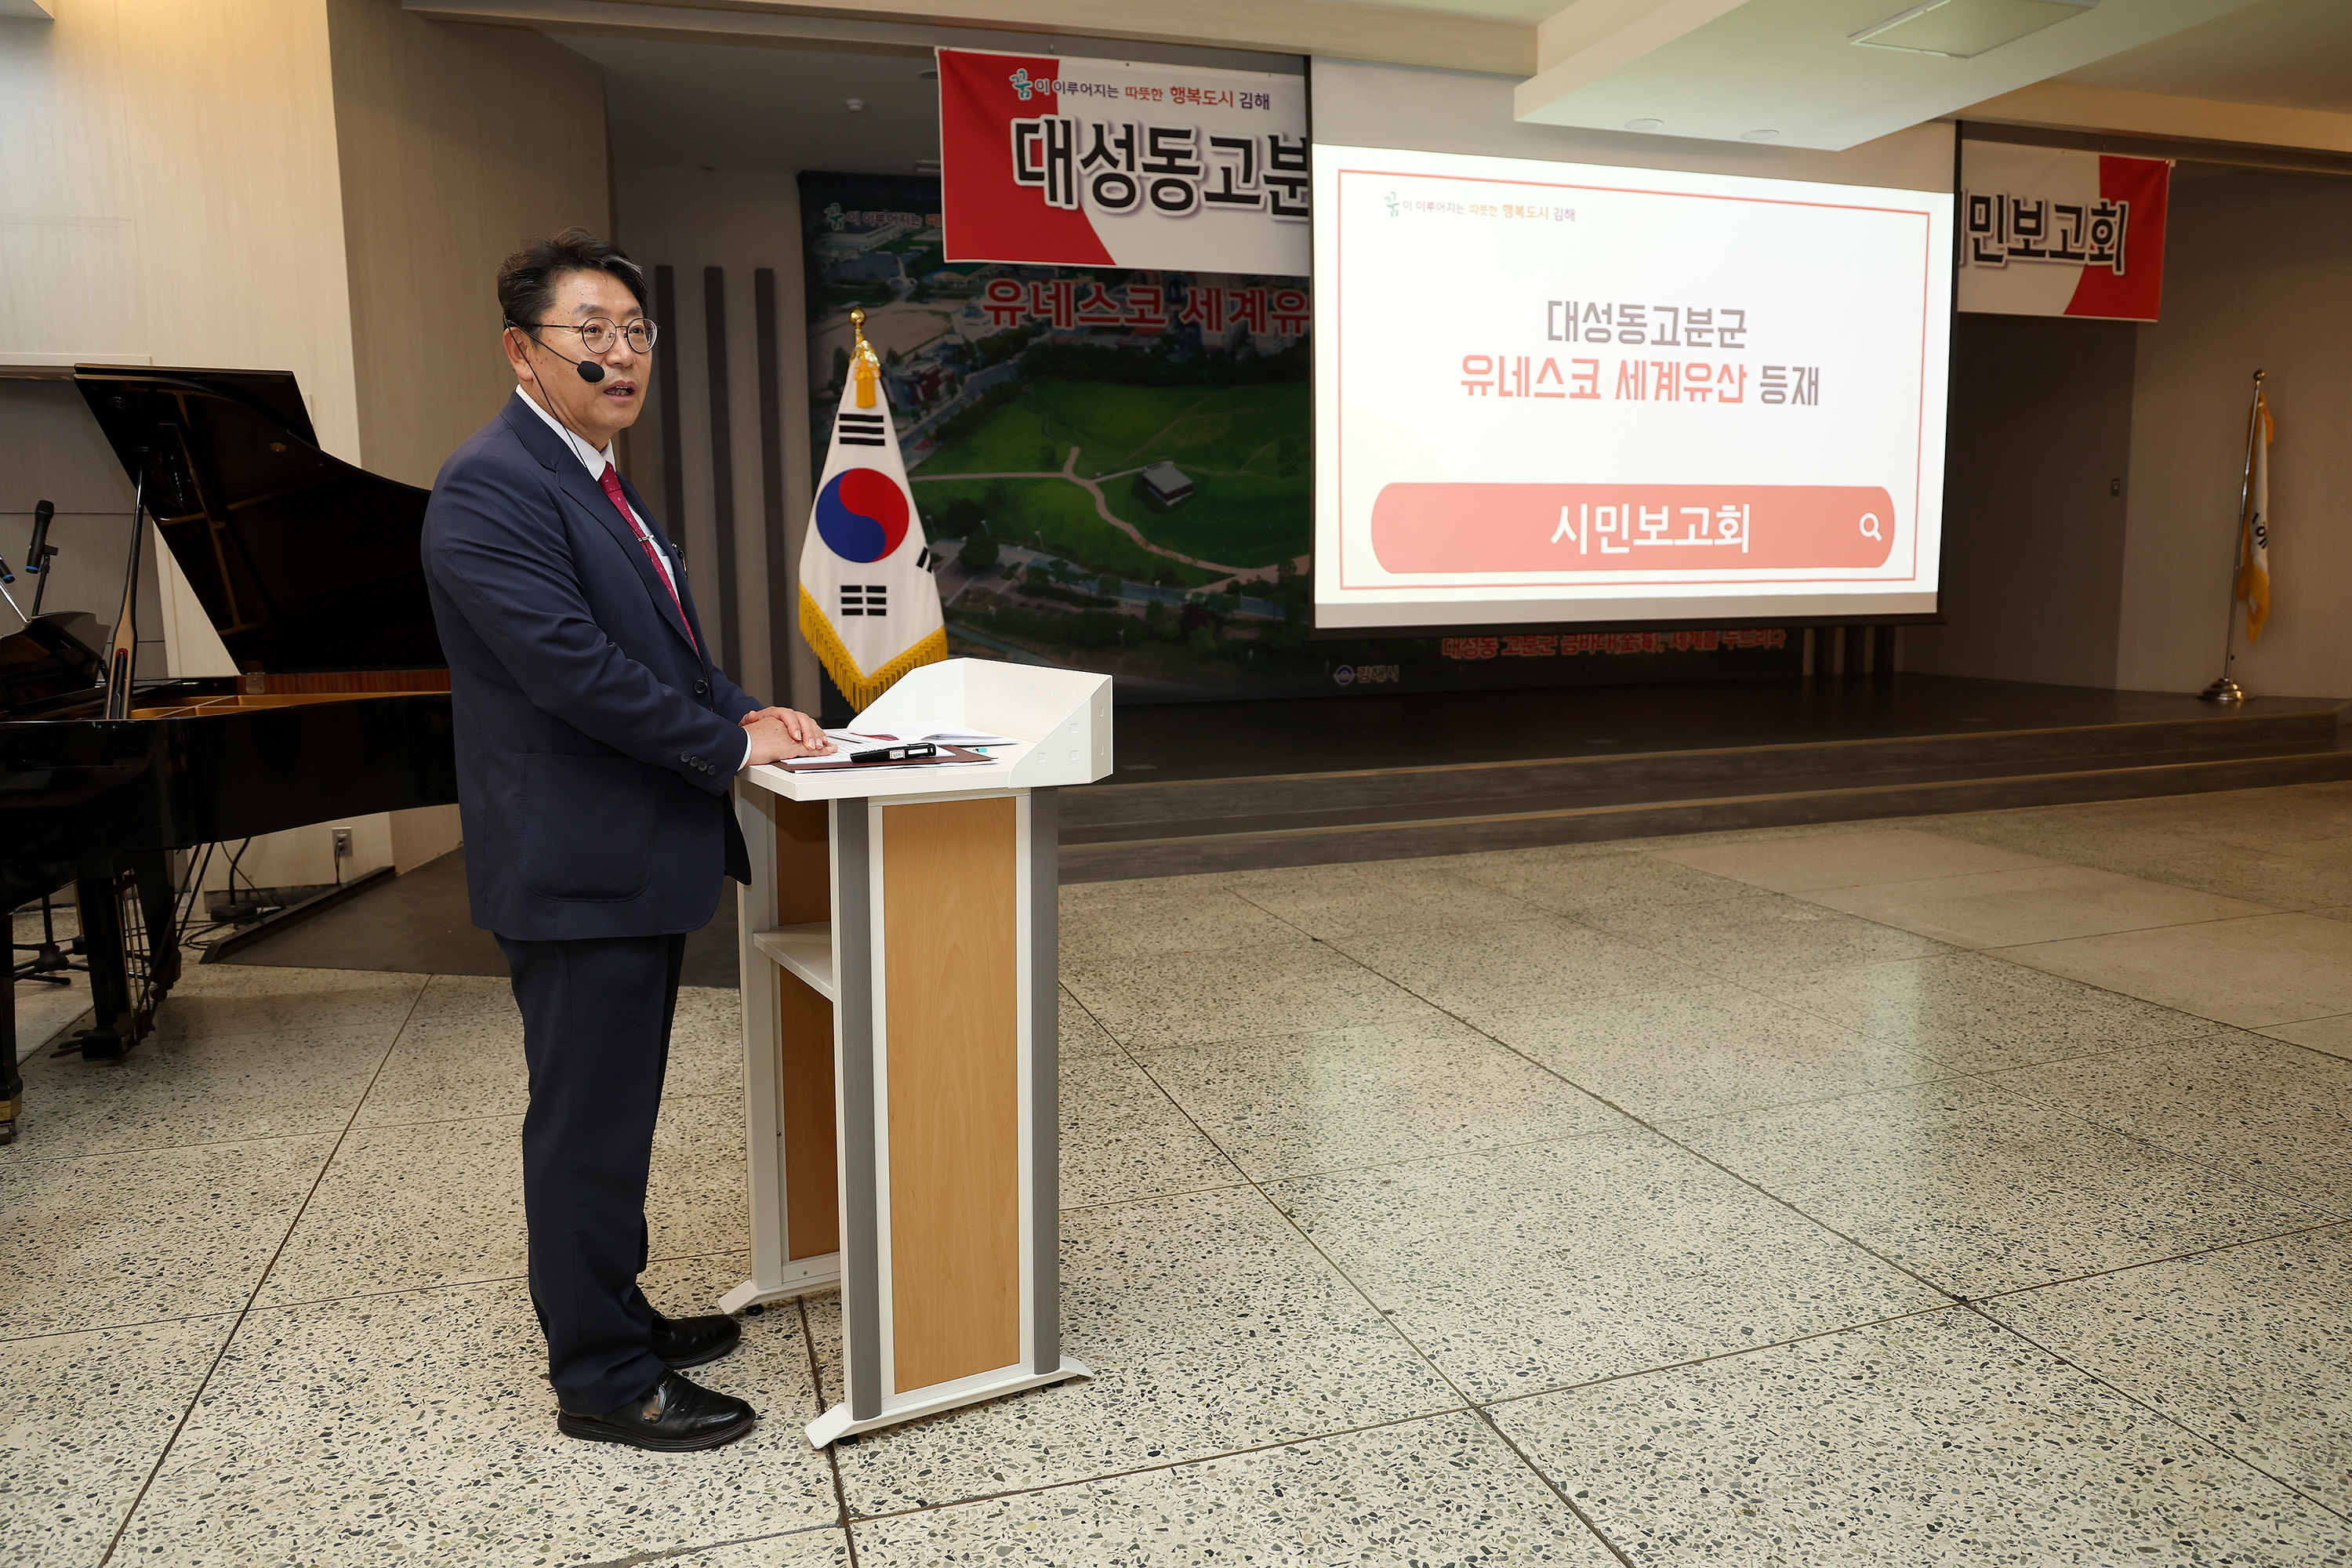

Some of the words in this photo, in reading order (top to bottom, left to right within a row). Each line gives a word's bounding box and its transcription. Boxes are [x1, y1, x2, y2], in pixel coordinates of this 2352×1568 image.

[1053, 79, 1119, 99] 이루어지는
[1124, 85, 1163, 102] 따뜻한
[1170, 85, 1234, 108] 행복도시
[1239, 91, 1270, 111] 김해
[862, 210, 923, 229] 이루어지는
[1416, 201, 1465, 215] 이루어지는
[1469, 203, 1498, 217] 따뜻한
[1502, 203, 1550, 220] 행복도시
[1553, 206, 1577, 222] 김해
[1960, 193, 2127, 273] 민보고회
[983, 279, 1168, 328] 유네스코
[1181, 287, 1310, 335] 세계유
[1547, 299, 1748, 349] 대성동고분군
[1460, 354, 1602, 399] 유네스코
[1616, 359, 1748, 404] 세계유산
[1759, 365, 1820, 406] 등재
[1550, 503, 1751, 555] 시민보고회
[1442, 636, 1499, 659] 대성동
[1356, 664, 1400, 684] 김해시
